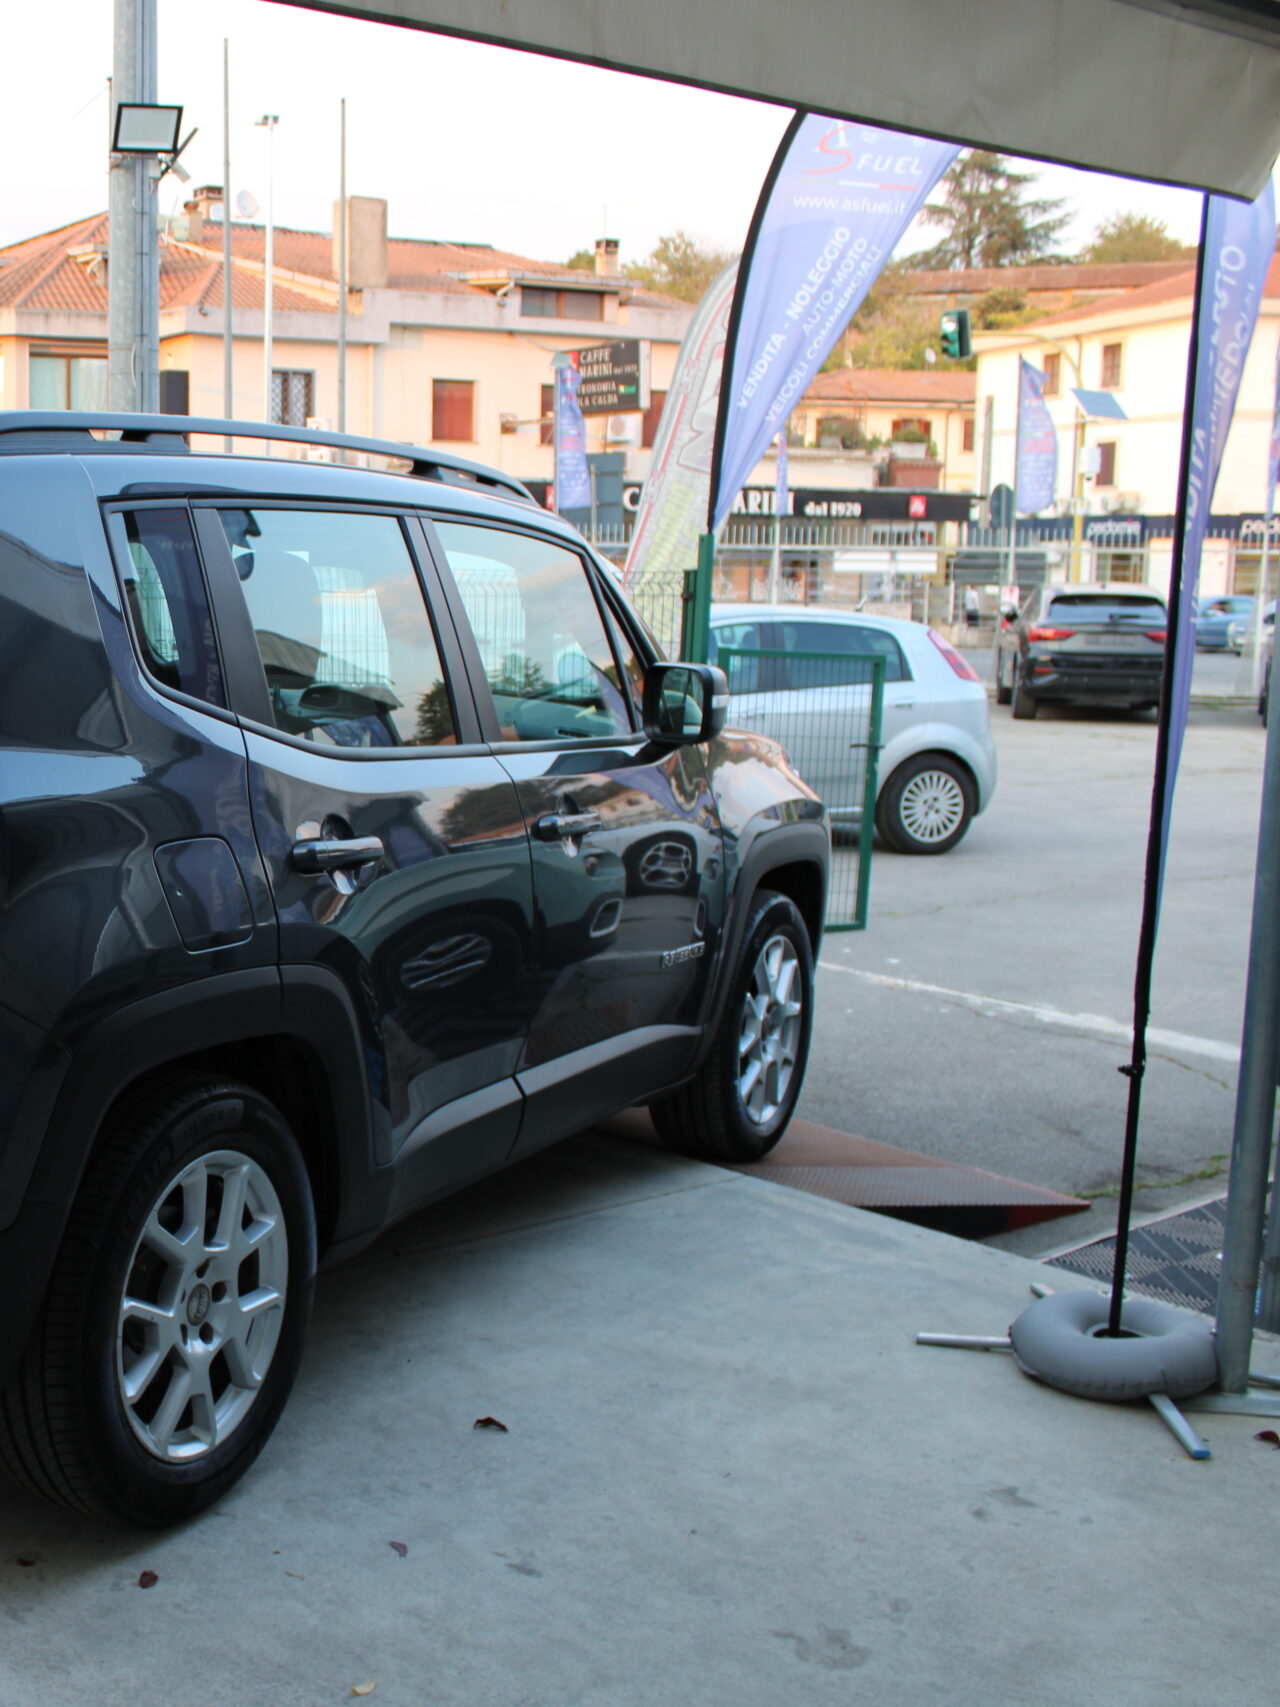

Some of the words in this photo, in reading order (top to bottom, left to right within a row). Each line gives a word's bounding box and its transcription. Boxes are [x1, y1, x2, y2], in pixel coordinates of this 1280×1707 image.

[856, 153, 923, 175] FUEL
[793, 195, 907, 216] www.asfuel.it
[802, 237, 868, 336] AUTO-MOTO
[736, 333, 787, 409] VENDITA
[786, 226, 851, 321] NOLEGGIO
[765, 362, 809, 423] VEICOLI
[806, 244, 883, 361] COMMERCIALI
[830, 501, 862, 518] 1920
